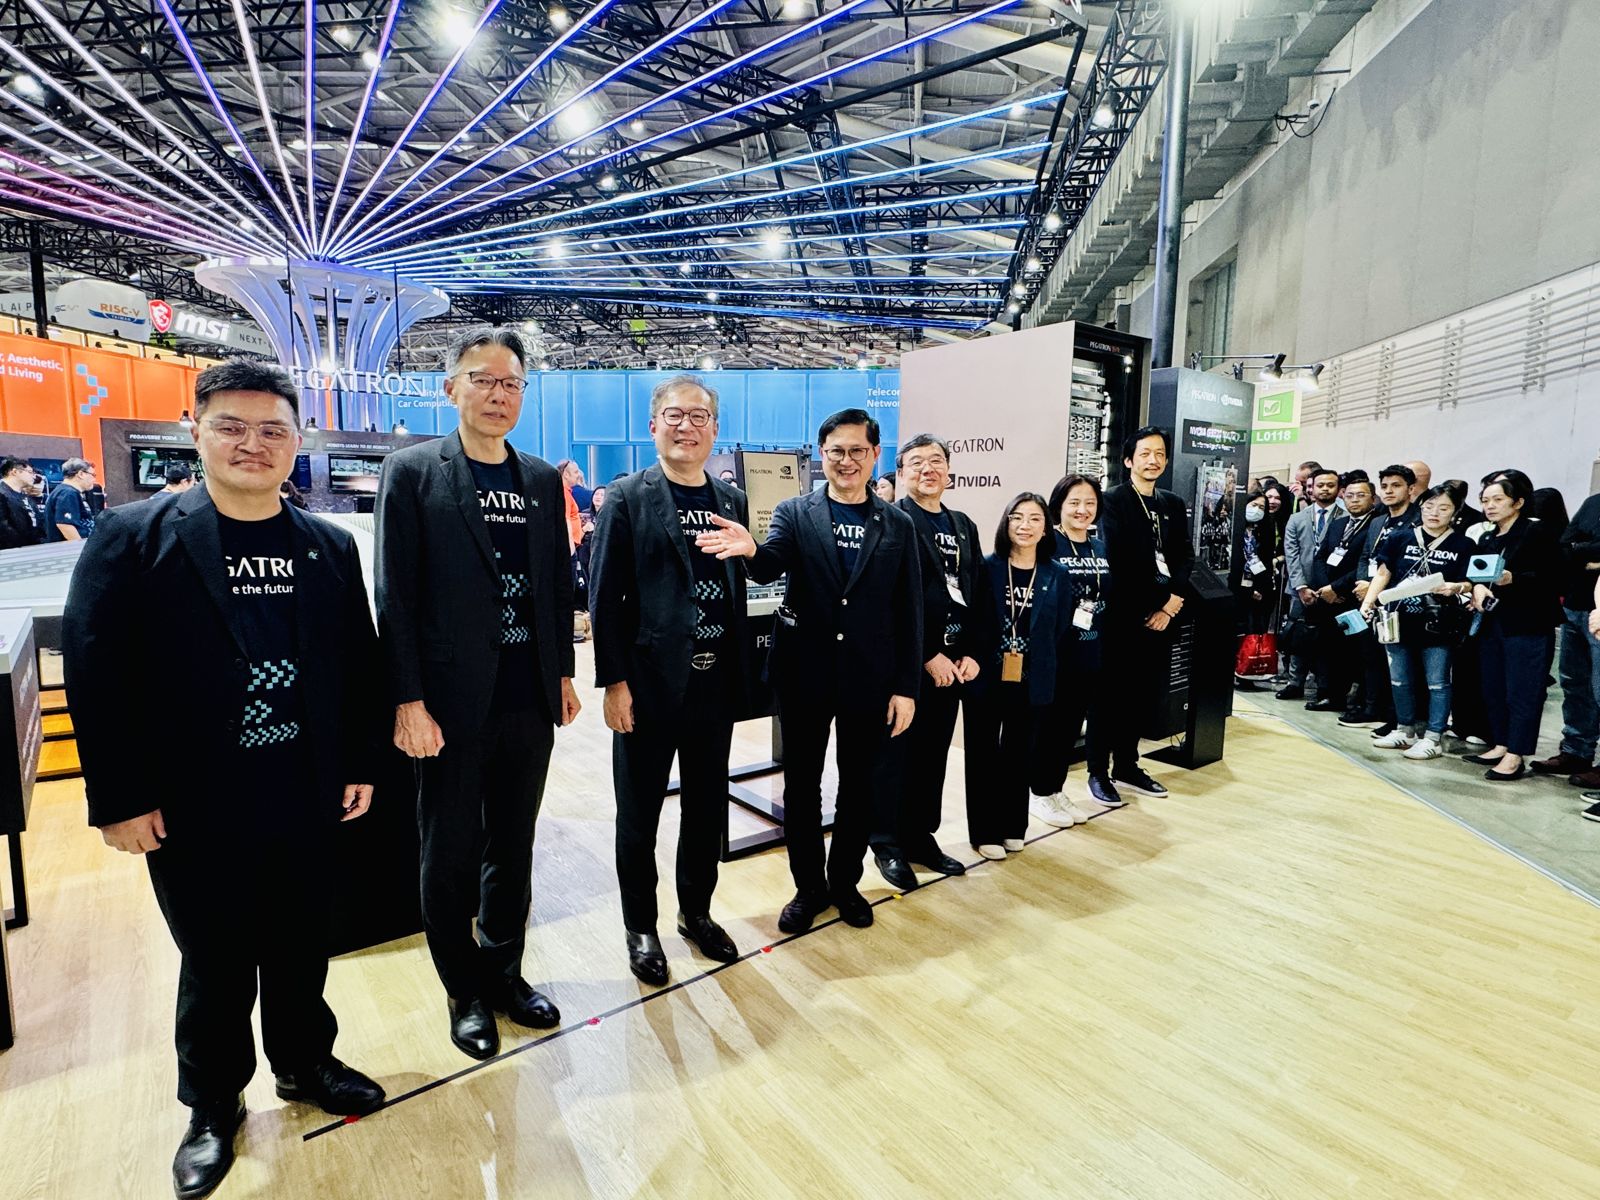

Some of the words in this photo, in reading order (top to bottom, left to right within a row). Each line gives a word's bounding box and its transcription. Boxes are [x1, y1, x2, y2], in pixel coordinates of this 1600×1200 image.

[100, 303, 140, 317] RISC-V
[175, 311, 230, 342] msi
[8, 353, 64, 373] Aesthetic,
[8, 366, 44, 383] Living
[286, 365, 425, 397] EGATRON
[397, 400, 411, 408] Car
[1256, 430, 1292, 442] L0118
[947, 437, 1005, 454] EGATRON
[957, 475, 1001, 488] NVIDIA
[490, 512, 505, 523] the
[837, 540, 849, 548] the
[849, 540, 861, 549] fut
[241, 583, 262, 595] the
[263, 583, 295, 595] futur
[756, 634, 772, 649] PE
